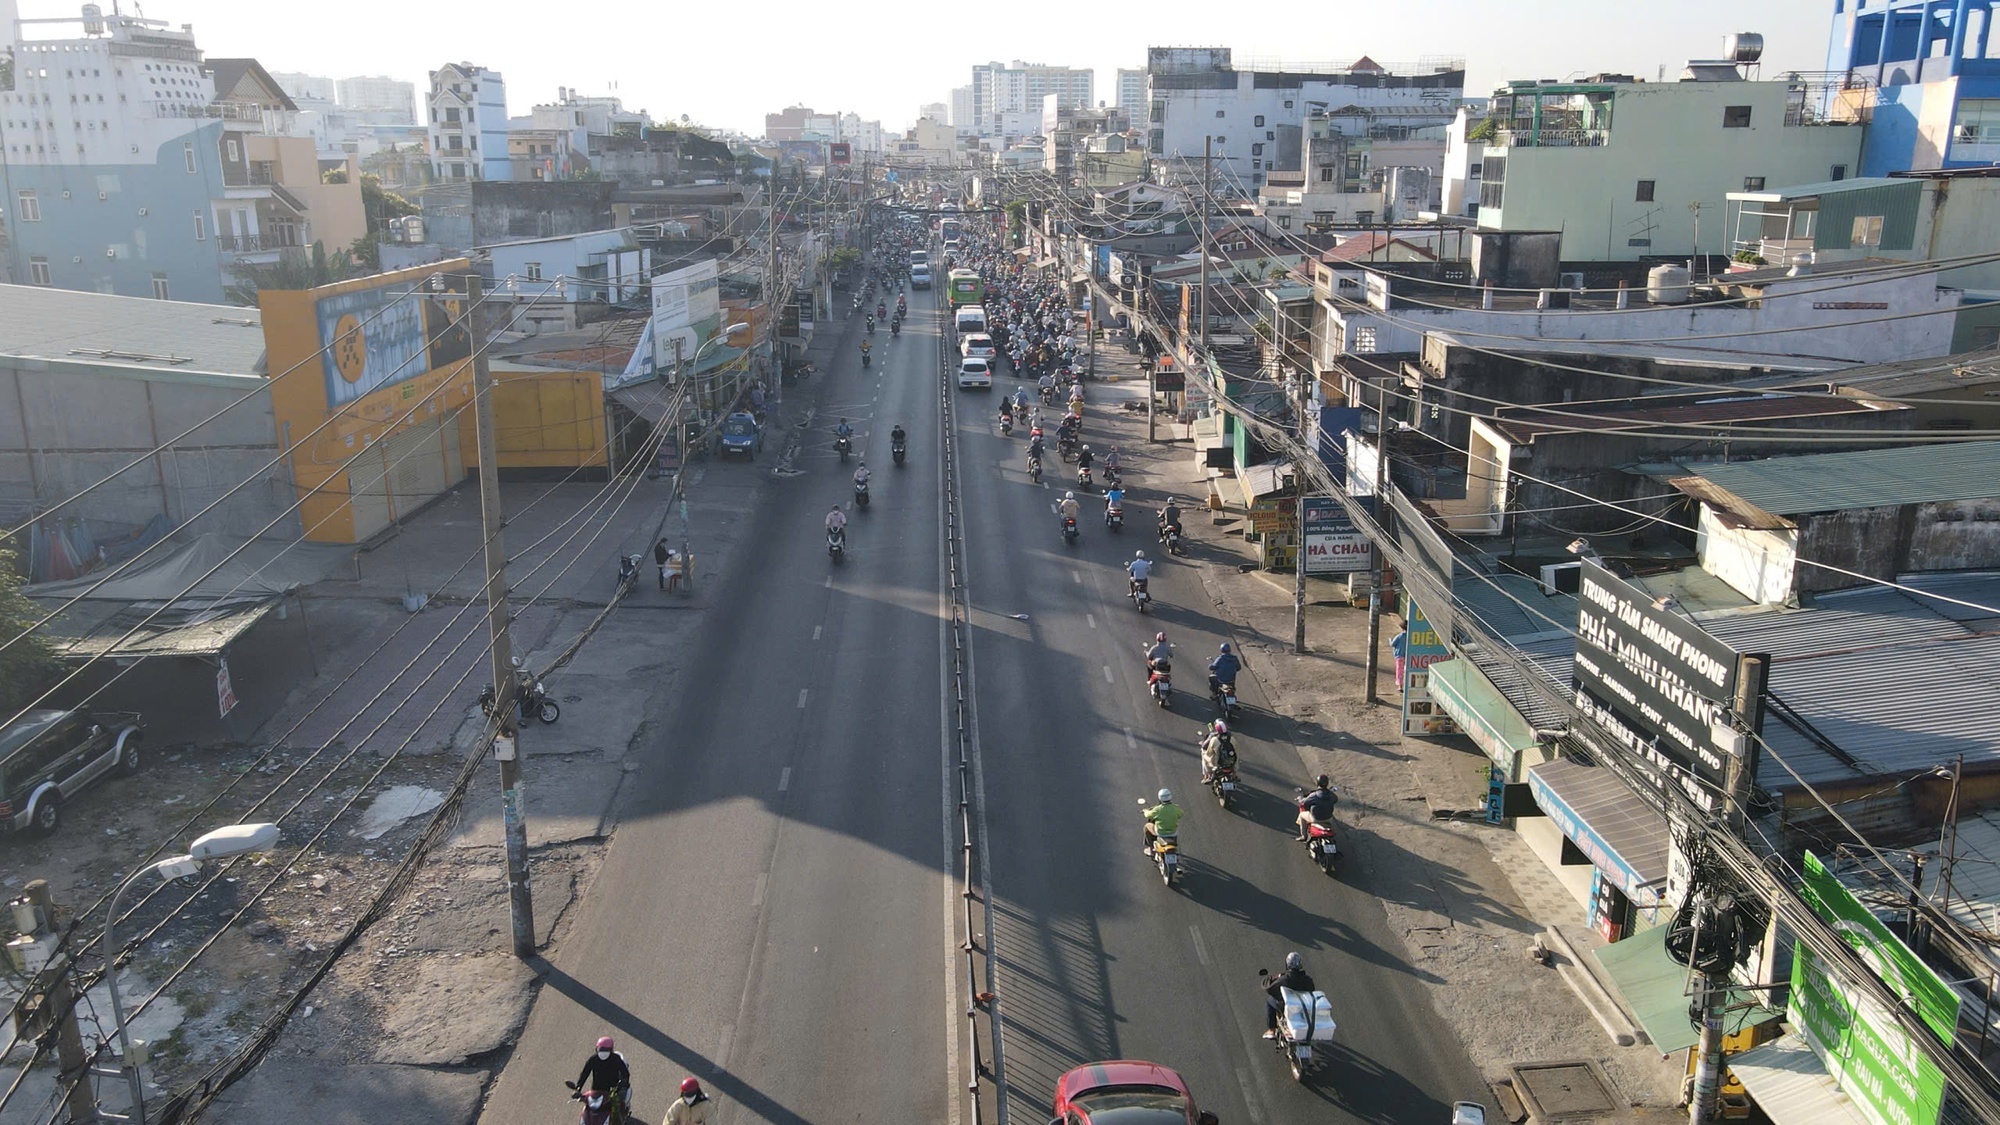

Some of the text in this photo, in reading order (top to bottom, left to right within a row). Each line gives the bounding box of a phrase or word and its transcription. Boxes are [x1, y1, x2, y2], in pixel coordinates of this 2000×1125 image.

[1579, 609, 1722, 728] PHÁT MINH KHANG
[1583, 577, 1728, 688] TRUNG TÂM SMART PHONE
[1575, 652, 1600, 677] IPHONE
[1603, 673, 1636, 705] SAMSUNG
[1640, 702, 1662, 726] SONY
[1666, 721, 1693, 751] NOKIA
[1699, 745, 1720, 770] VIVO
[1855, 1058, 1872, 1088] RAU
